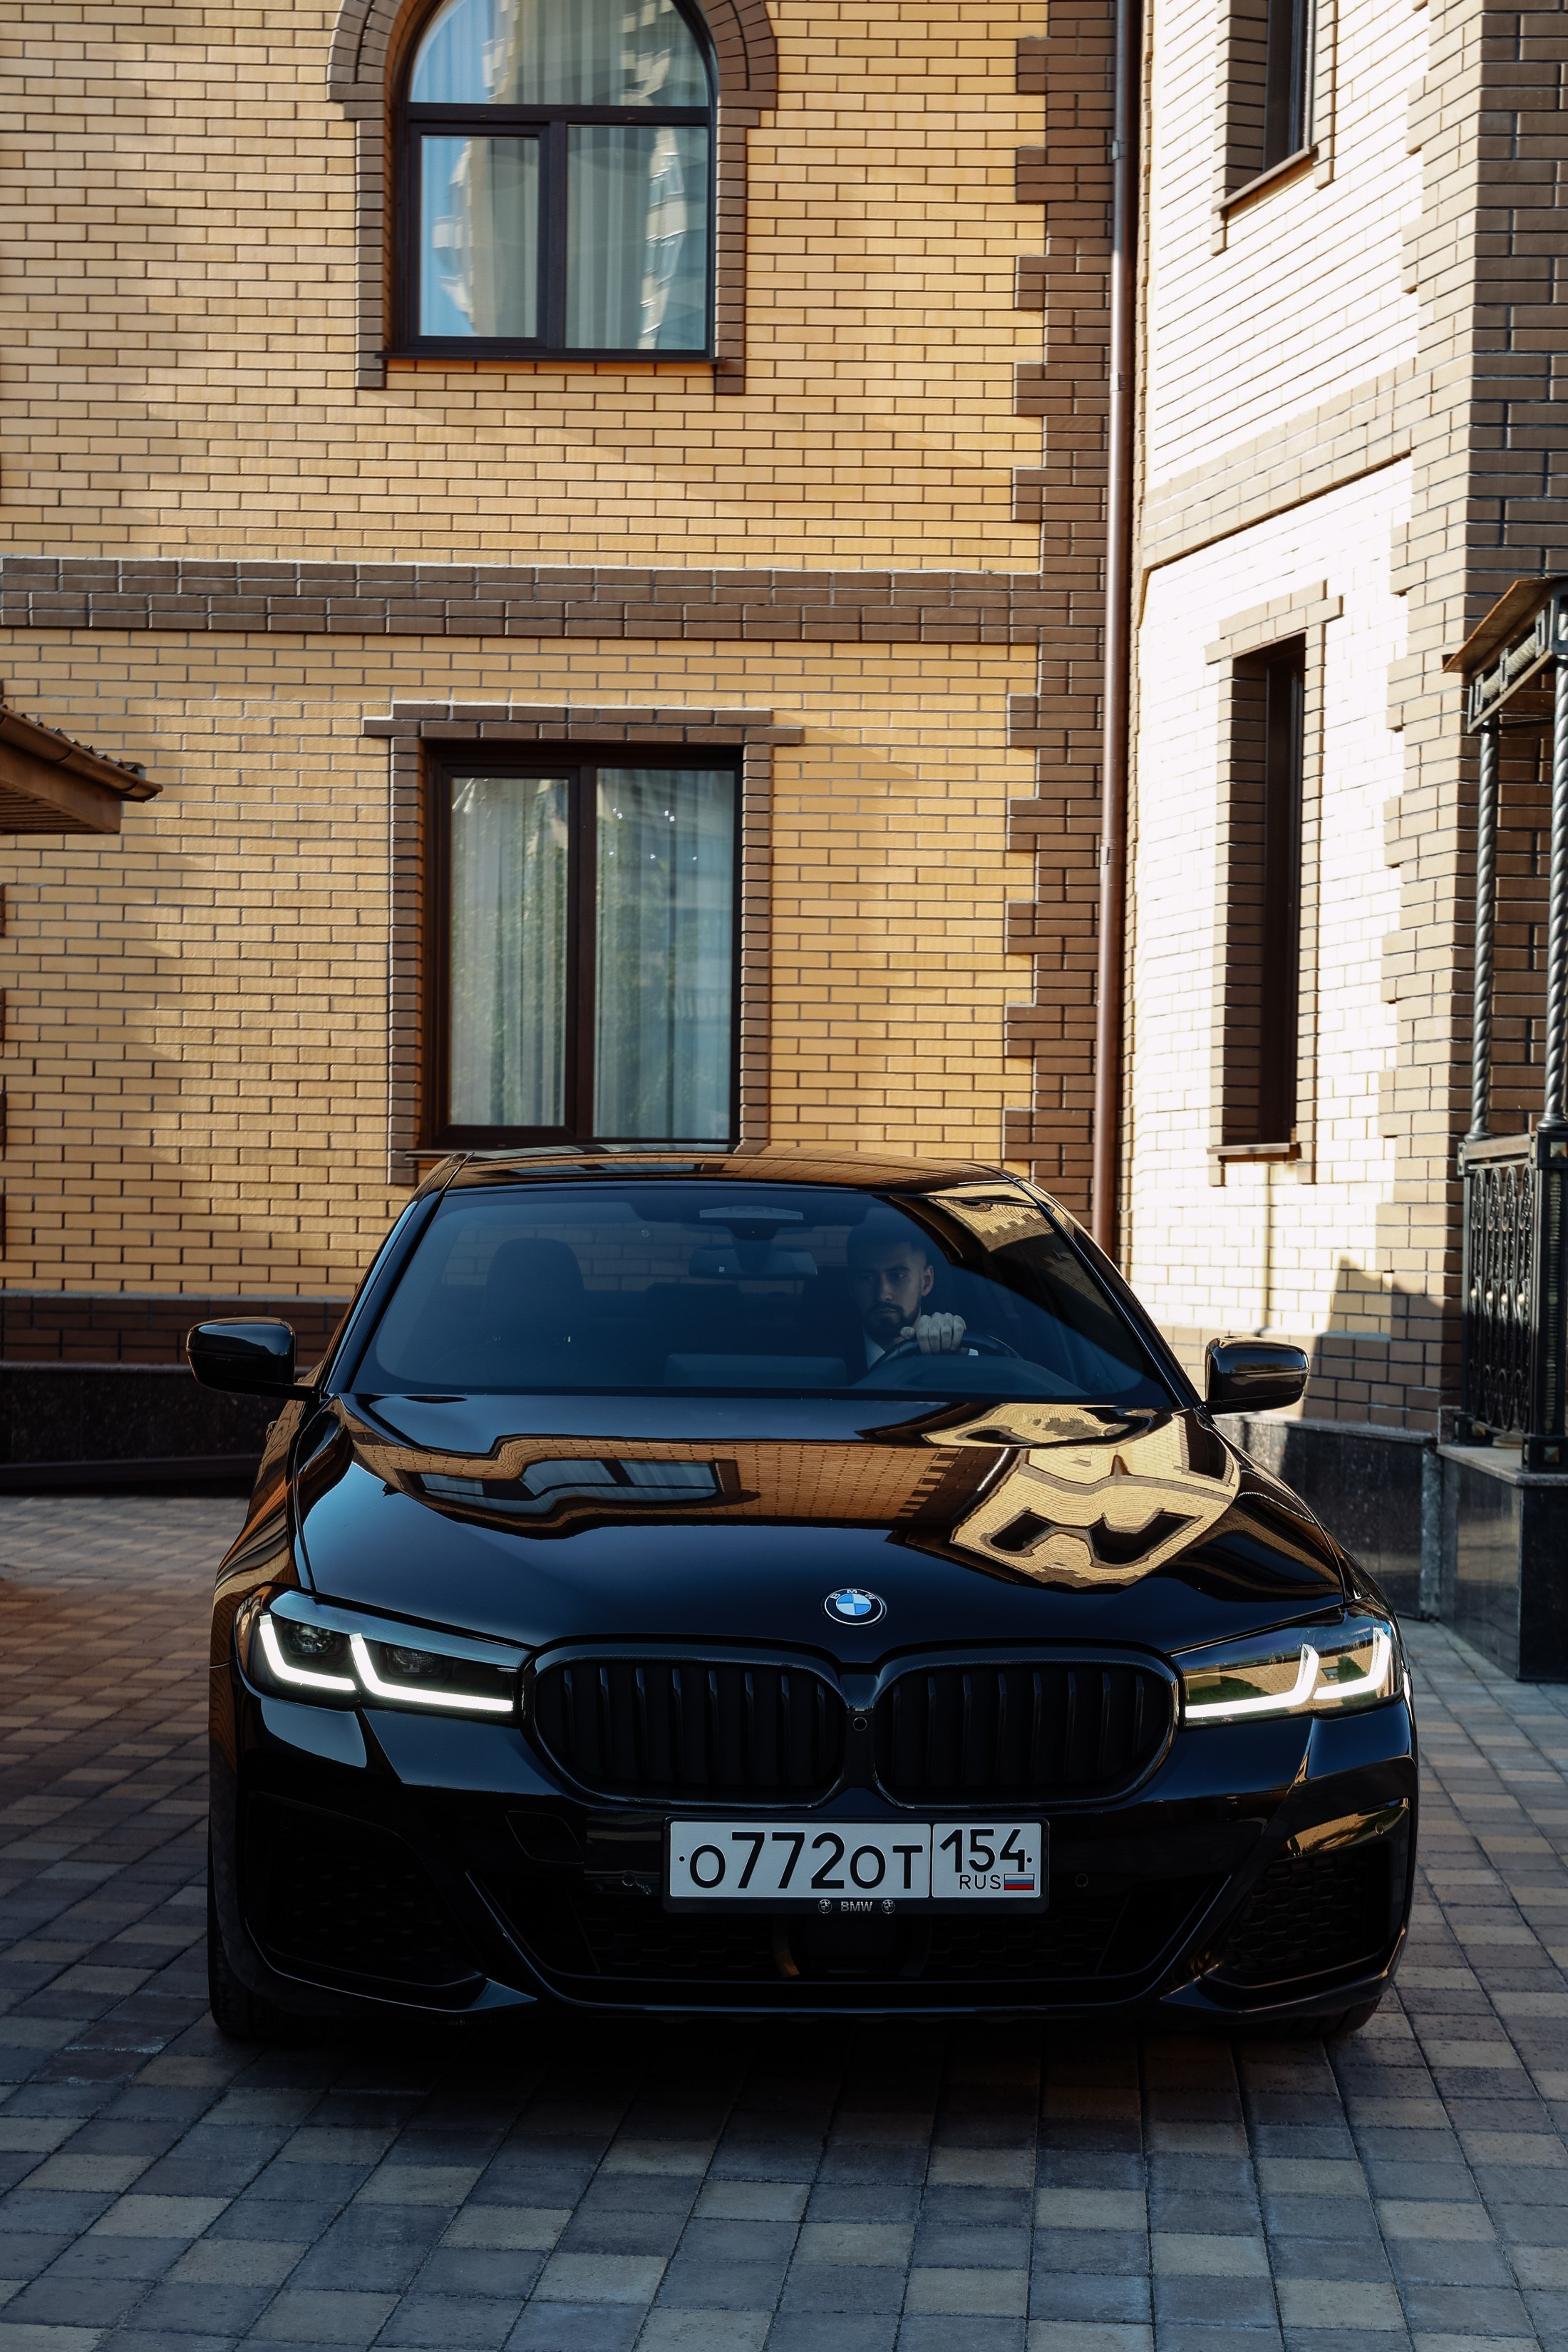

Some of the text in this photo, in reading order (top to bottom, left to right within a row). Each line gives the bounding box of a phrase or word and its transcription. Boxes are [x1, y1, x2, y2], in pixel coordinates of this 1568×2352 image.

[830, 1589, 876, 1599] BMW
[939, 1828, 1026, 1873] 154
[959, 1874, 1001, 1890] RUS
[841, 1901, 873, 1912] BMW
